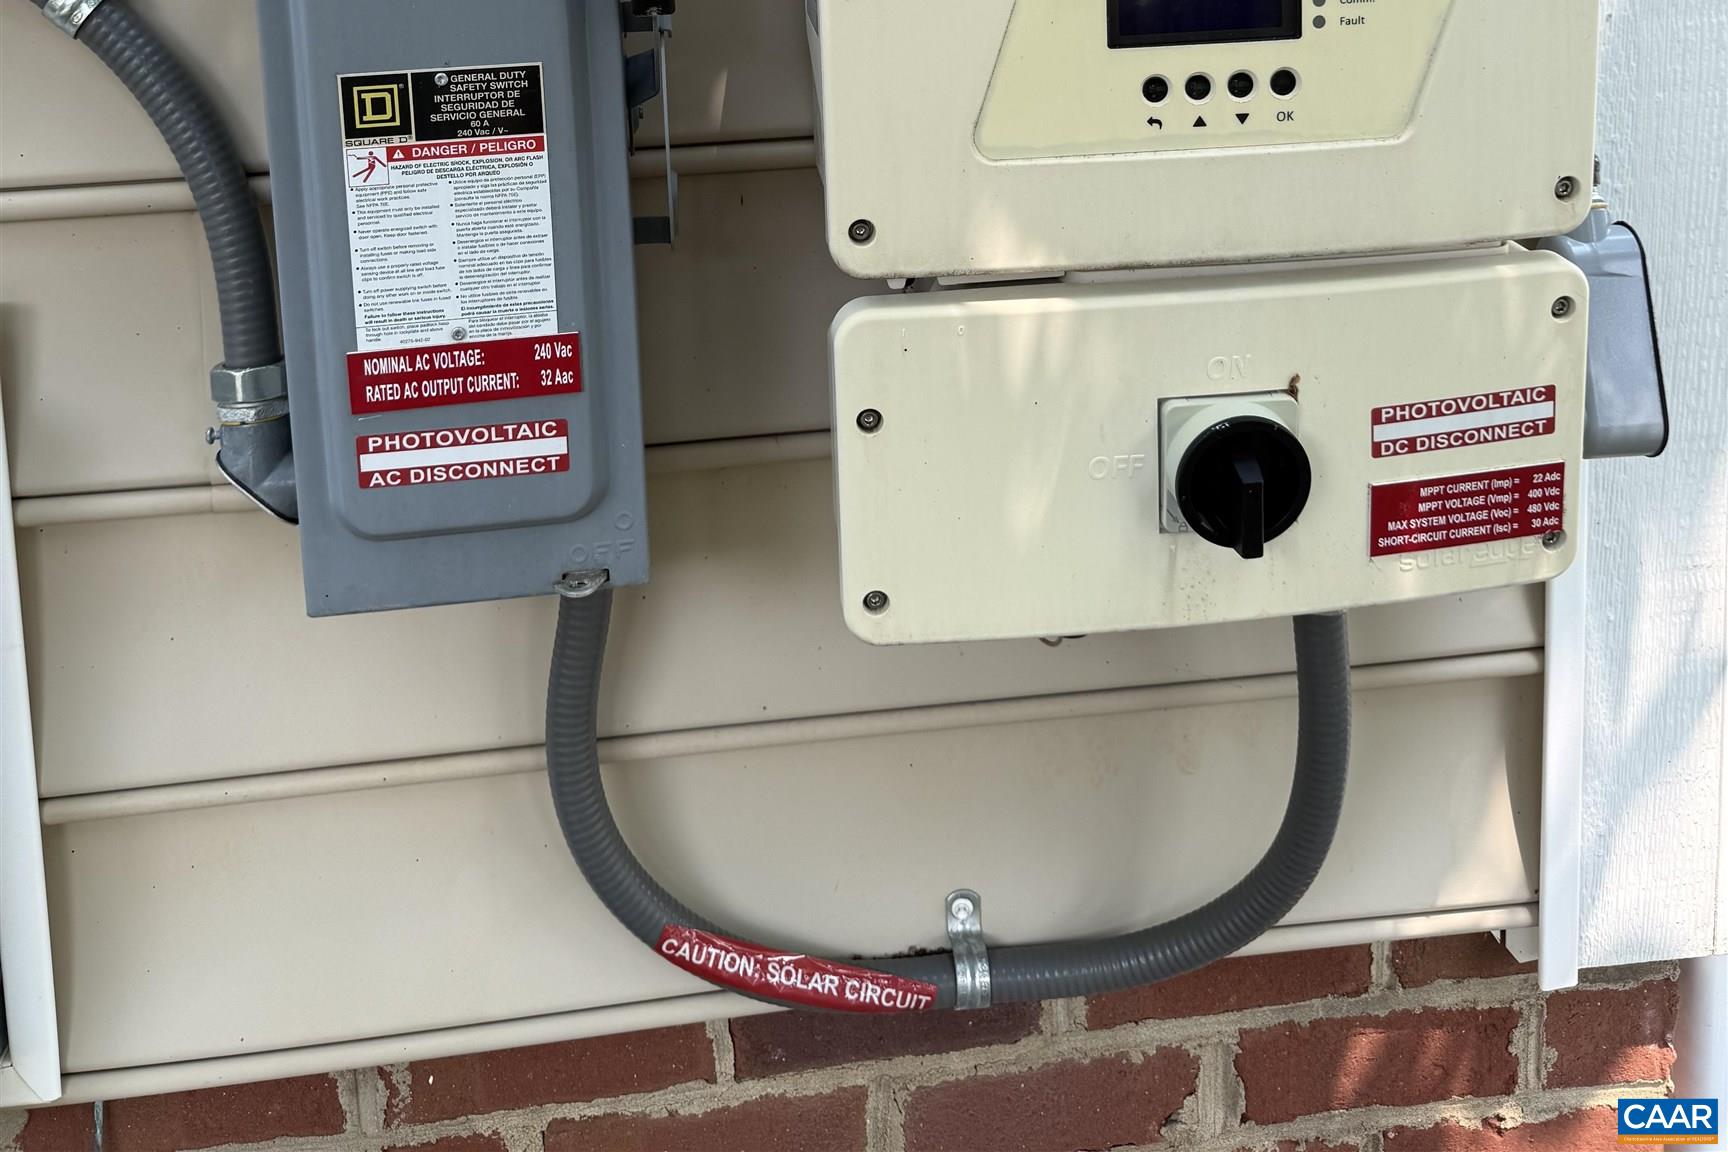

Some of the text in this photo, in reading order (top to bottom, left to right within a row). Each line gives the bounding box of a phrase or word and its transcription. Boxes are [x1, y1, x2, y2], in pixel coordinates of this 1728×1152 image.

[1339, 15, 1366, 26] Fault
[450, 70, 526, 82] GENERAL DUTY
[450, 80, 528, 92] SAFETY SWITCH
[434, 90, 520, 102] INTERRUPTOR DE
[440, 99, 514, 111] SEGURIDAD DE
[430, 108, 525, 121] SERVICIO GENERAL
[1276, 111, 1295, 122] OK
[345, 137, 394, 147] SQUARE
[412, 139, 536, 157] DANGER / PELIGRO
[364, 342, 572, 375] NOMINAL AC VOLTAGE: 240 Vac
[1207, 355, 1253, 380] ON
[366, 368, 573, 402] RATED AC OUTPUT CURRENT: 32 Aac
[1379, 387, 1545, 422] PHOTOVOLTAIC
[368, 421, 556, 452] PHOTOVOLTAIC
[1381, 420, 1546, 455] DC DISCONNECT
[369, 456, 560, 487] AC DISCONNECT
[1088, 454, 1145, 480] OFF
[1419, 485, 1445, 497] MPPT
[1446, 479, 1489, 494] CURRENT
[1490, 476, 1512, 490] (Imp)
[1533, 472, 1543, 483] 22
[1544, 471, 1561, 482] Adc
[1418, 500, 1443, 512] MPPT
[1444, 495, 1485, 509] VOLTAGE
[1487, 491, 1512, 506] (Vmp)
[1527, 488, 1543, 498] 400
[1543, 486, 1560, 496] Vdc
[1387, 519, 1408, 531] MAX
[1409, 515, 1446, 529] SYSTEM
[1447, 509, 1488, 524] VOLTAGE
[1490, 507, 1511, 520] (Voc)
[1527, 502, 1542, 513] 480
[1543, 501, 1560, 511] Vdc
[1378, 530, 1447, 547] SHORT-CIRCUIT
[1448, 524, 1491, 539] CURRENT
[1493, 522, 1511, 535] (Isc)
[1531, 517, 1541, 528] 30
[1542, 516, 1559, 526] Adc
[766, 961, 840, 997] SOLAR
[844, 980, 932, 1010] CIRCUIT
